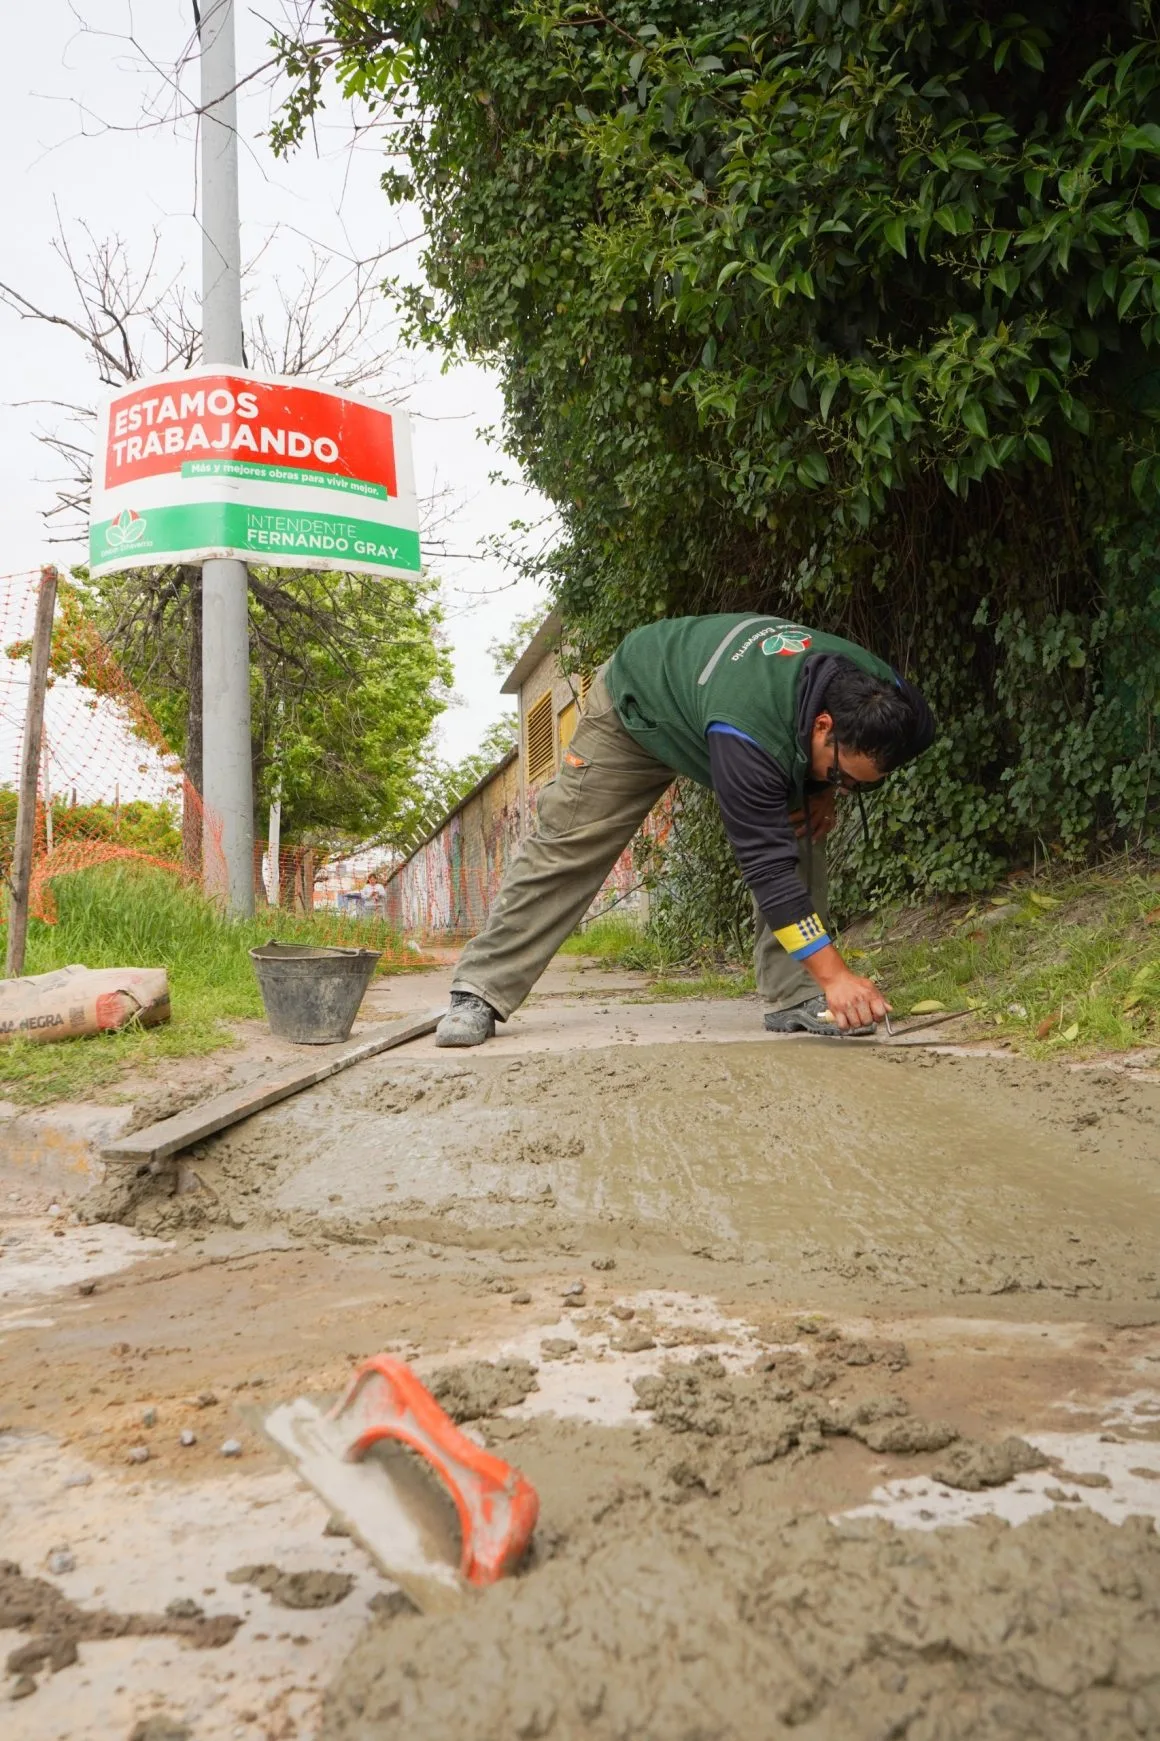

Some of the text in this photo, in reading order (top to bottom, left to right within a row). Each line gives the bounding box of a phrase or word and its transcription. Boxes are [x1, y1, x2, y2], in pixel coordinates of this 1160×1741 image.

[114, 388, 259, 437] ESTAMOS
[112, 422, 339, 467] TRABAJANDO
[191, 462, 379, 496] Más y mejores obras para vivir mejor.
[247, 513, 357, 538] INTENDENTE
[247, 529, 398, 560] FERNANDO GRAY
[20, 1013, 64, 1029] NEGRA
